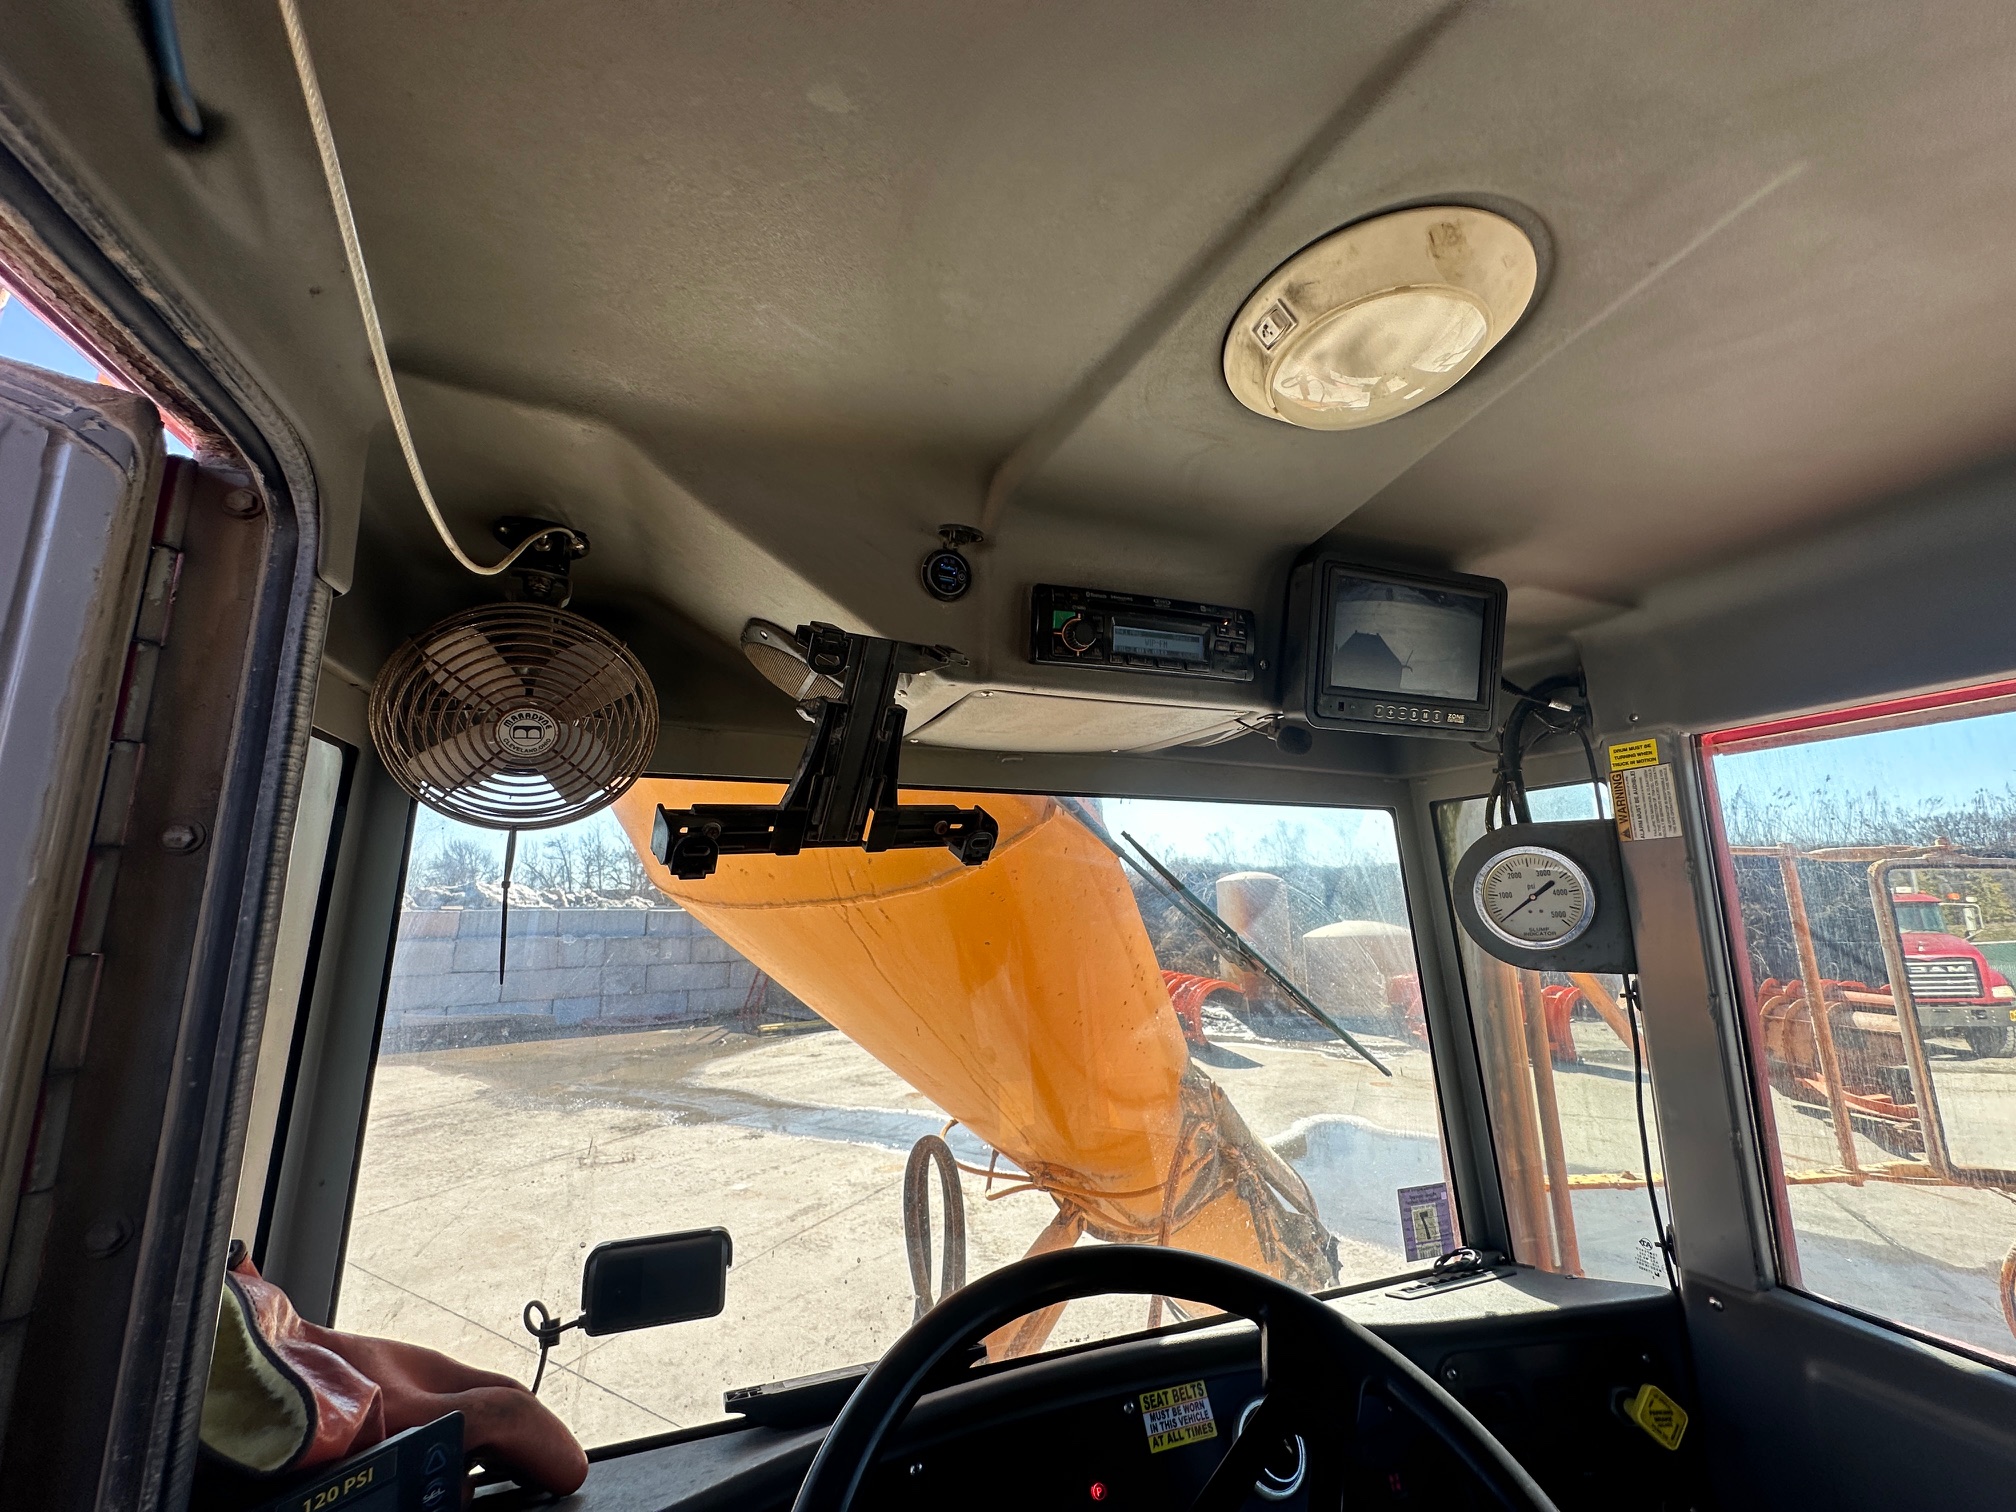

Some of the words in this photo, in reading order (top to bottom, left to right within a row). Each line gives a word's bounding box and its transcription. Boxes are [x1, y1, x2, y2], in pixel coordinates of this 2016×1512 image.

[503, 713, 553, 729] MARADYNE
[538, 738, 551, 750] OHIO
[1612, 773, 1628, 824] WARNING
[1633, 796, 1640, 804] BE
[1527, 883, 1536, 891] psi
[1142, 1391, 1169, 1411] SEAT
[1172, 1382, 1204, 1403] BELTS
[1149, 1409, 1169, 1422] MUST
[1172, 1407, 1182, 1417] BE
[1183, 1401, 1205, 1414] WORN
[1150, 1422, 1158, 1433] IN
[1160, 1418, 1178, 1431] THIS
[1178, 1410, 1209, 1426] VEHICLE
[1152, 1435, 1164, 1449] AT
[1167, 1431, 1185, 1445] ALL
[1185, 1422, 1214, 1437] TIMES
[303, 1485, 339, 1512] 120
[344, 1466, 374, 1497] PSI
